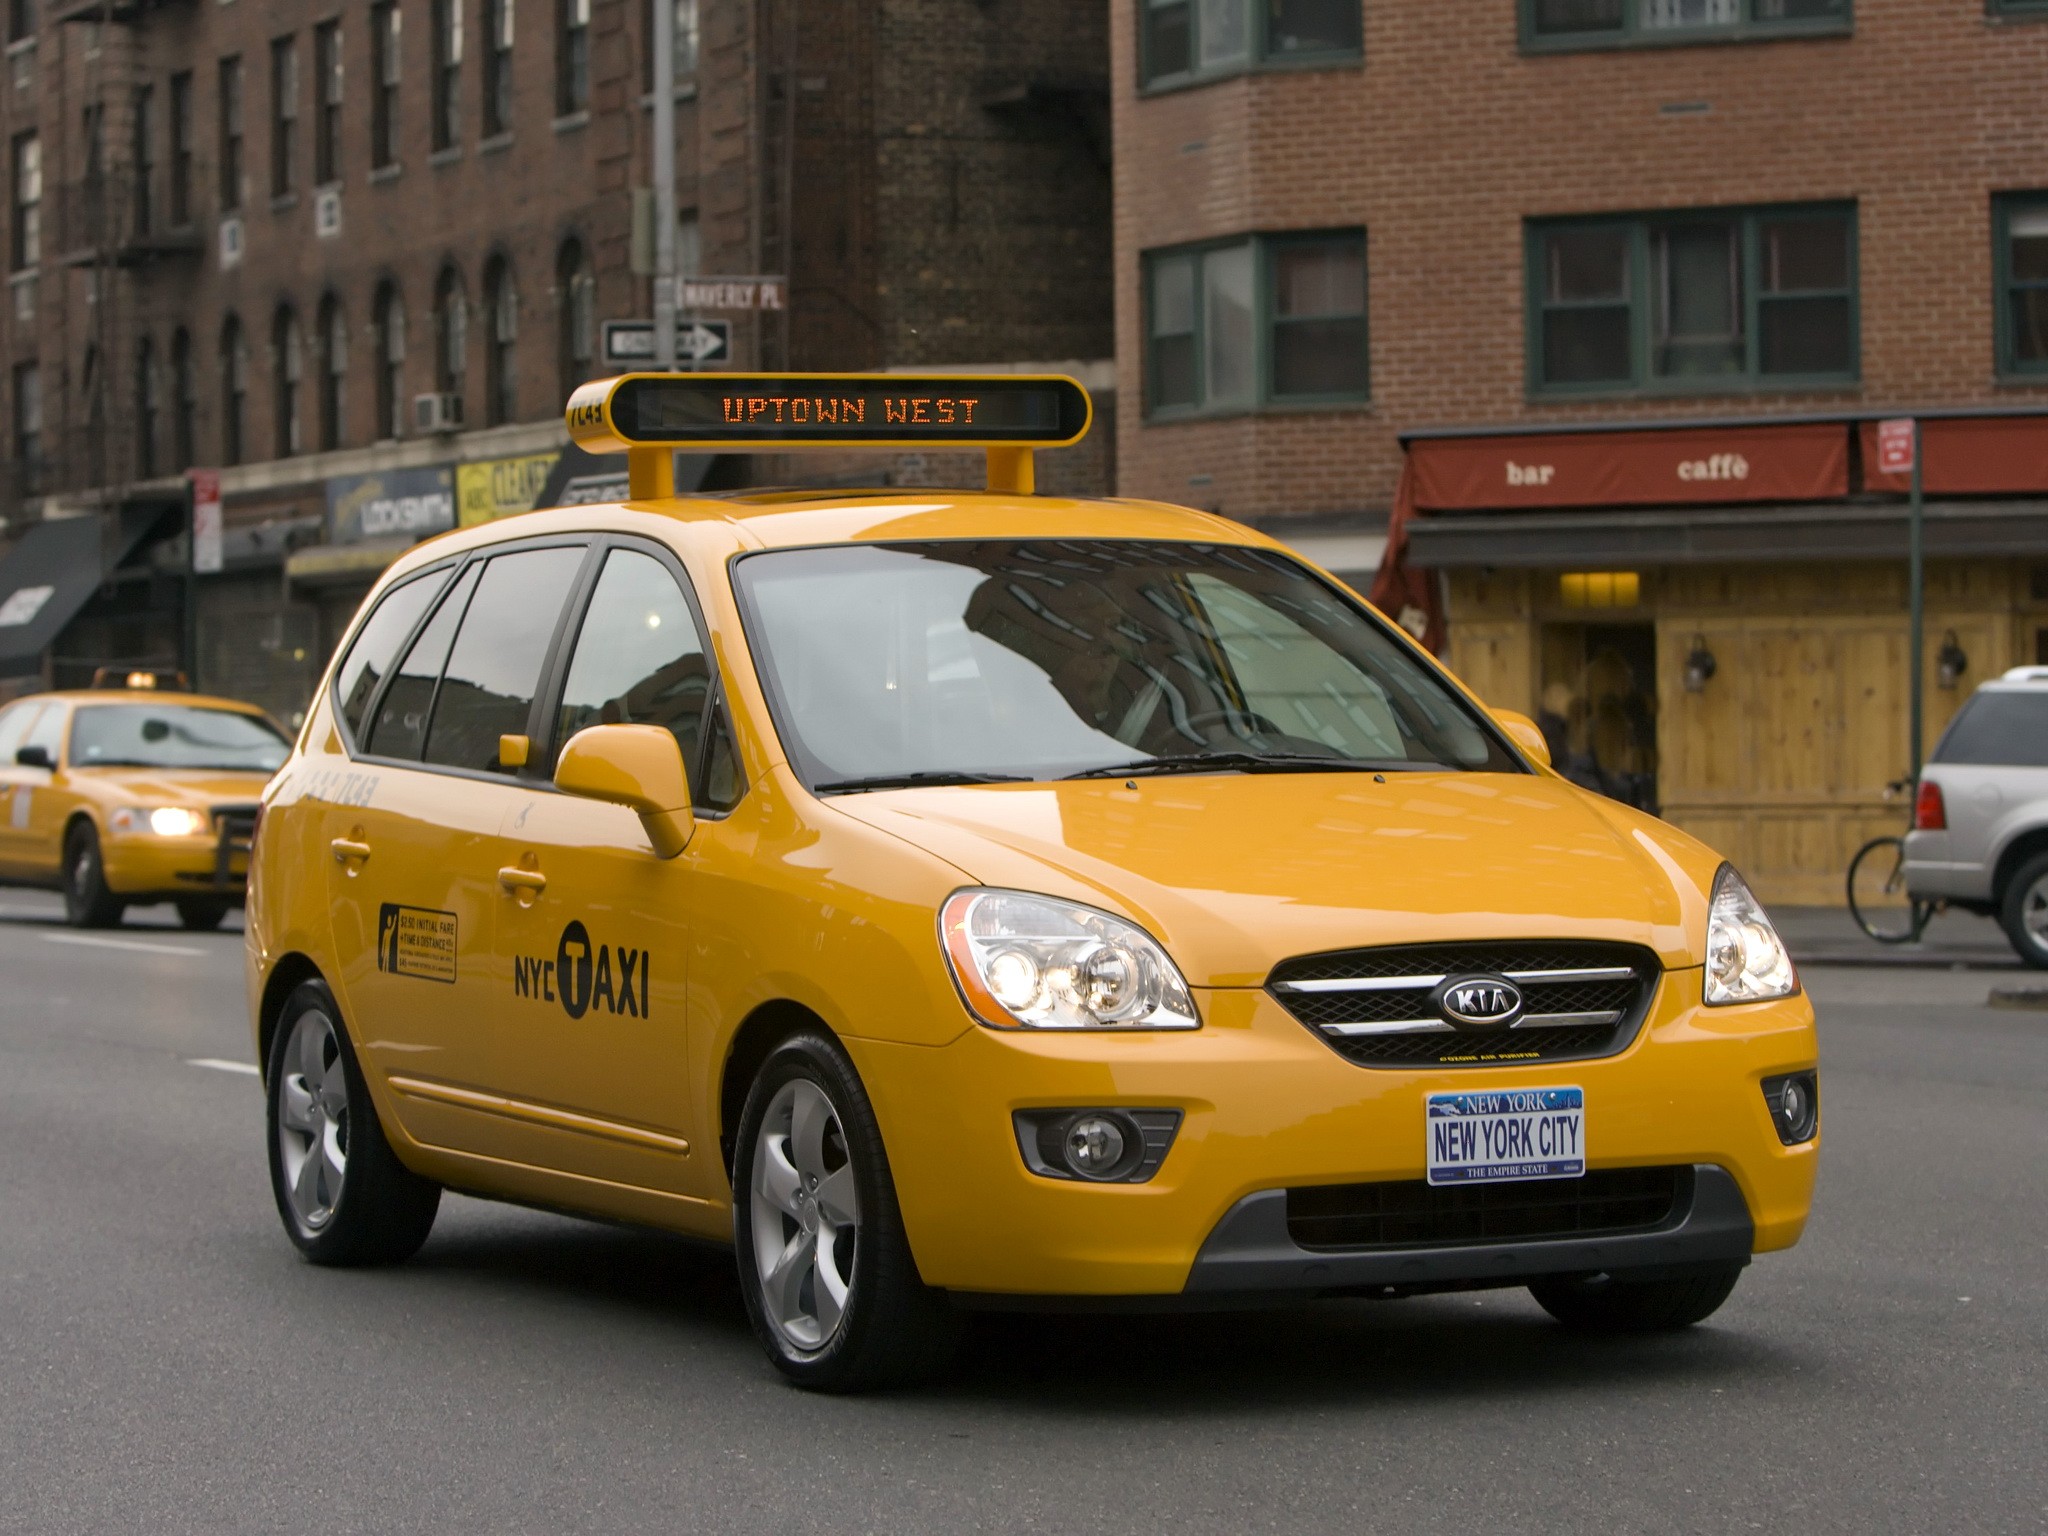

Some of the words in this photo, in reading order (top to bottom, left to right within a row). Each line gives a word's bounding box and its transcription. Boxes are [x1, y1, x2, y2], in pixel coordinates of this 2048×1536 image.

[685, 283, 754, 309] WAVERLY
[760, 283, 783, 310] PL
[723, 398, 865, 423] UPTOWN
[884, 398, 978, 423] WEST
[1505, 461, 1555, 486] bar
[1676, 453, 1749, 481] caffè
[360, 493, 455, 534] LOCKSMITH
[417, 917, 438, 934] INITIAL
[440, 922, 455, 936] FARE
[421, 935, 446, 951] DISTANCE
[515, 954, 555, 1003] NYC
[557, 922, 649, 1020] TAXI
[1456, 988, 1511, 1013] KIA
[1480, 1052, 1497, 1061] AIR
[1498, 1050, 1541, 1060] PURIFIER
[1466, 1095, 1501, 1115] NEW
[1505, 1092, 1548, 1112] YORK
[1434, 1120, 1477, 1163] NEW
[1481, 1117, 1535, 1160] YORK
[1538, 1114, 1580, 1157] CITY
[1466, 1167, 1486, 1179] THE
[1487, 1165, 1520, 1178] EMPIRE
[1521, 1163, 1549, 1176] STATE
